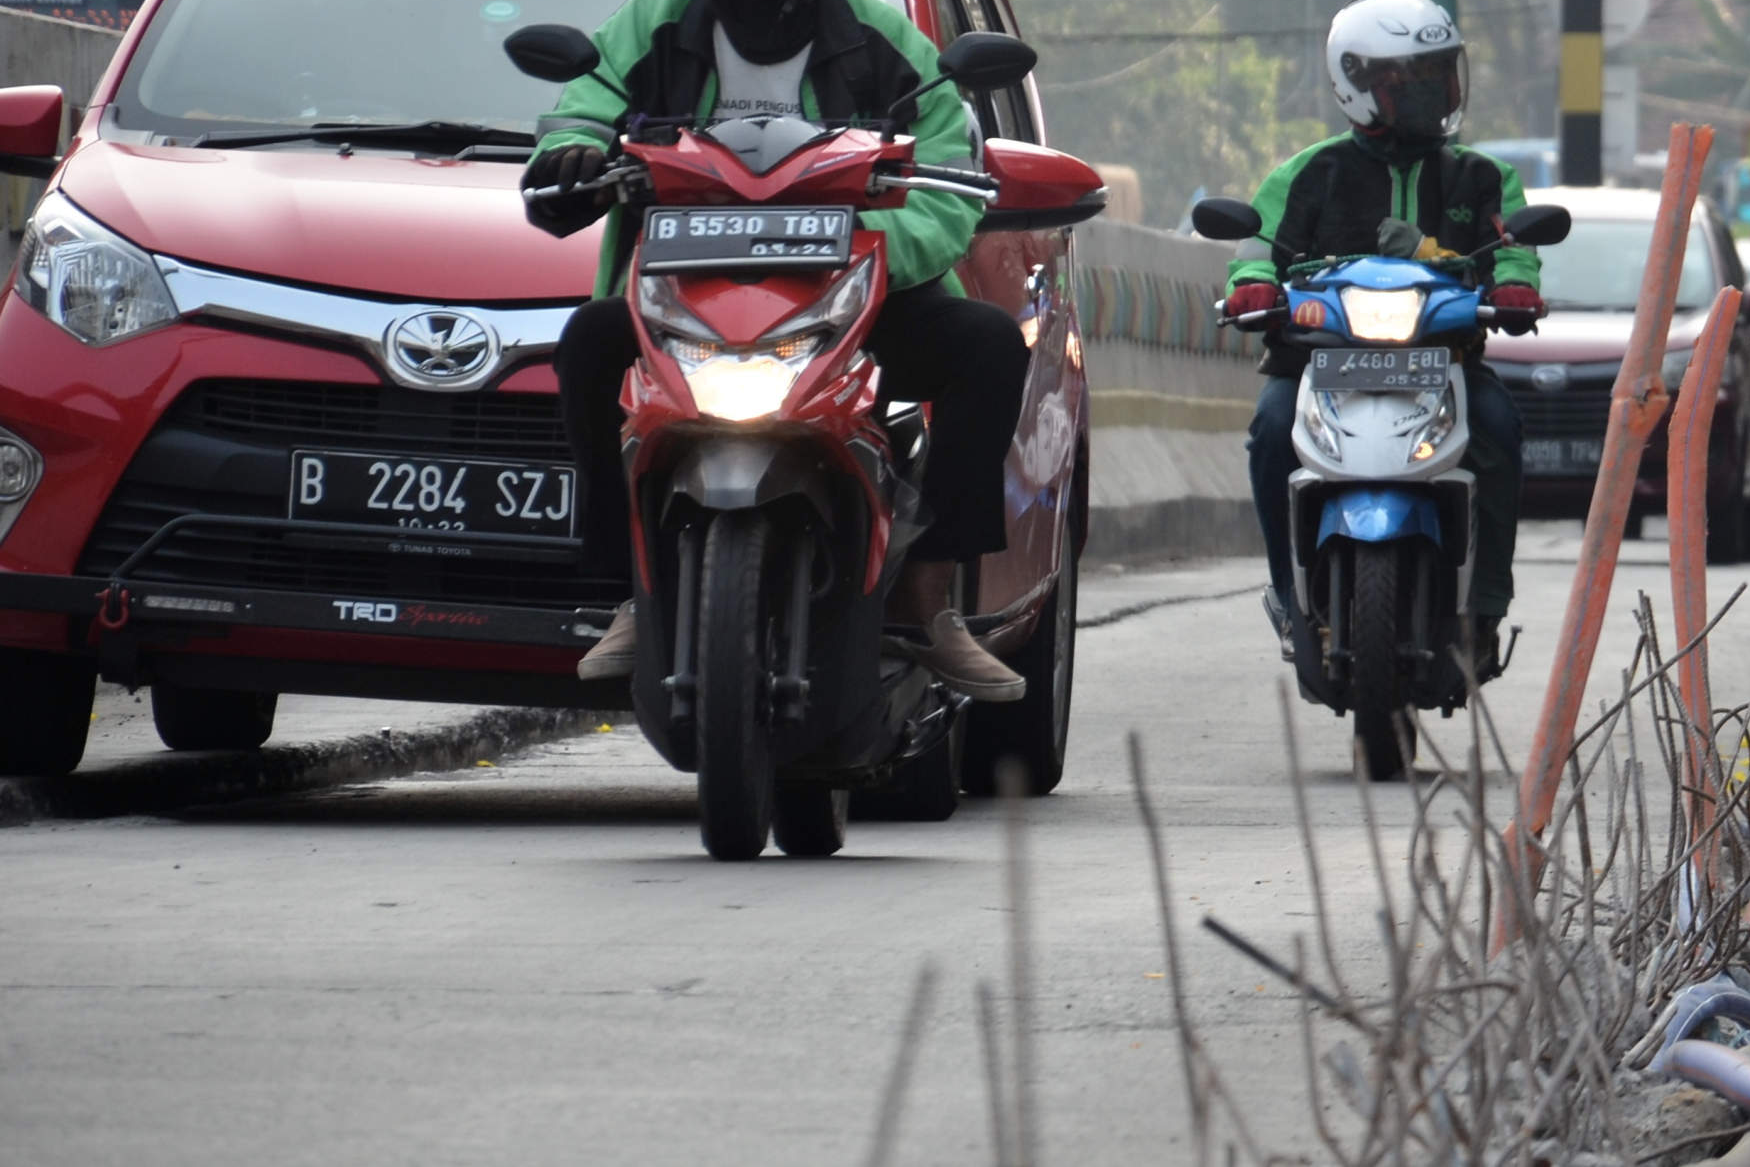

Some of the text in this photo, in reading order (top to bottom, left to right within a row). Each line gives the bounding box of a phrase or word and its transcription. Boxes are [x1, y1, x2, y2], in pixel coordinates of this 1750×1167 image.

[658, 216, 840, 239] B 5530 TBV
[1316, 352, 1328, 369] B
[300, 457, 570, 521] B 2284 SZJ
[437, 546, 472, 556] TOYOTA
[332, 600, 398, 623] TRD
